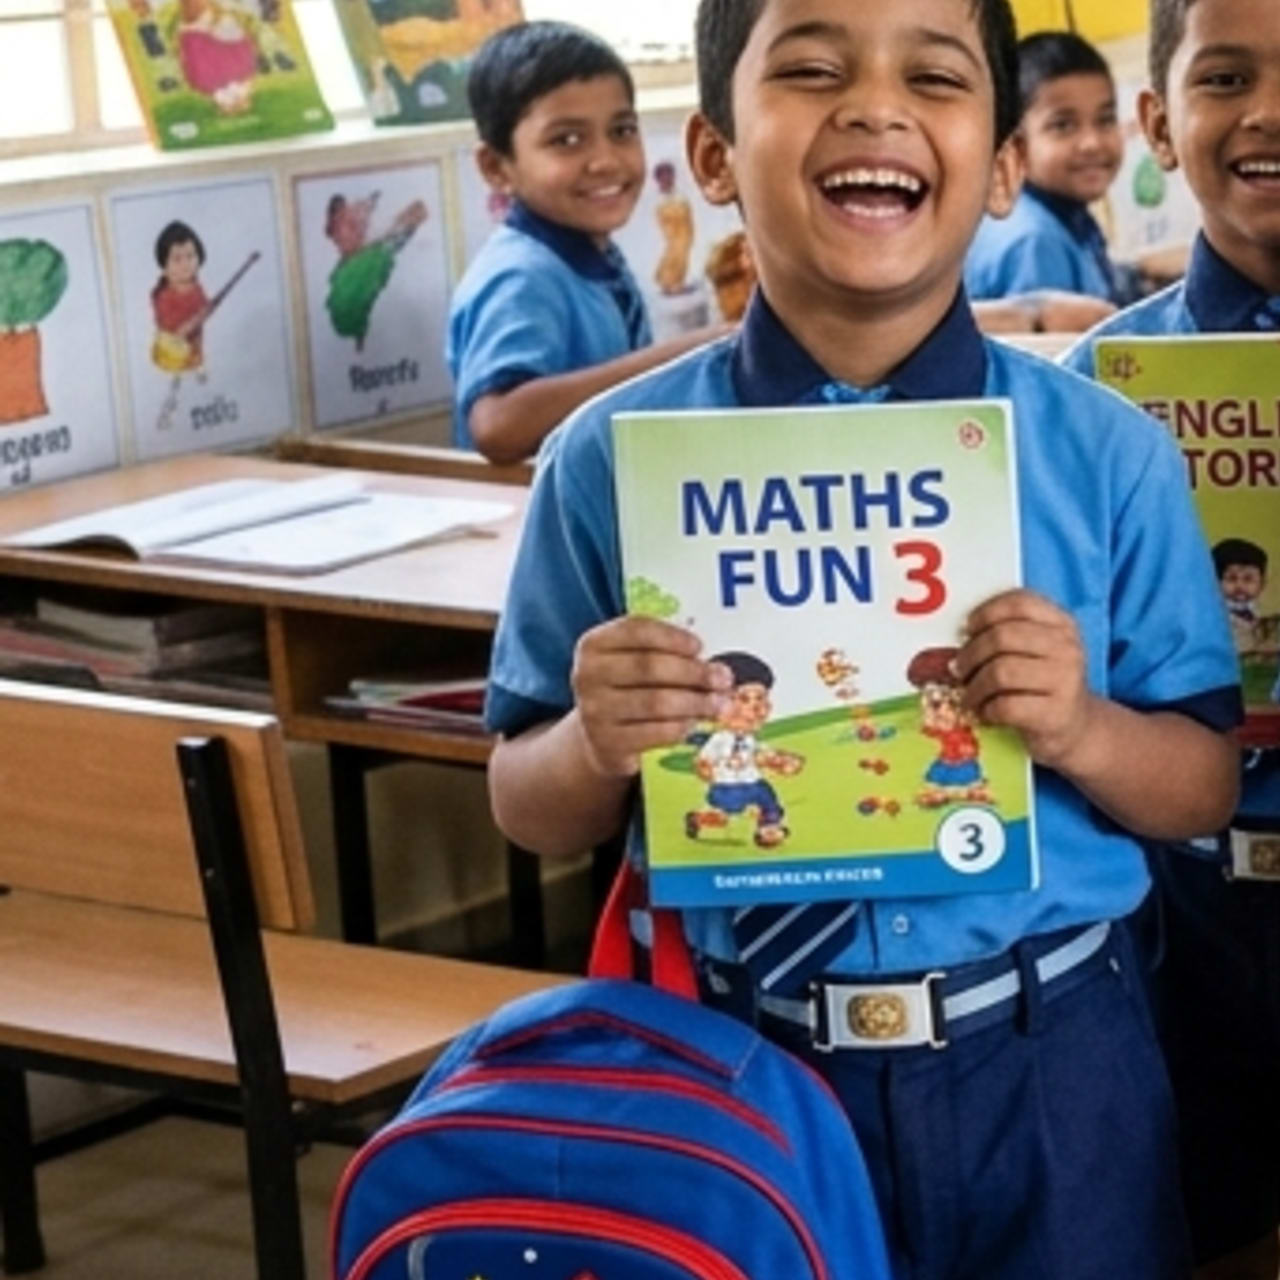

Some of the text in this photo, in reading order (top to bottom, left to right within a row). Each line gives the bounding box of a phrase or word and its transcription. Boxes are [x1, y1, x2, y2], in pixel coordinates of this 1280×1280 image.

[681, 469, 951, 537] MATHS
[718, 540, 948, 616] FUN 3
[958, 822, 986, 862] 3
